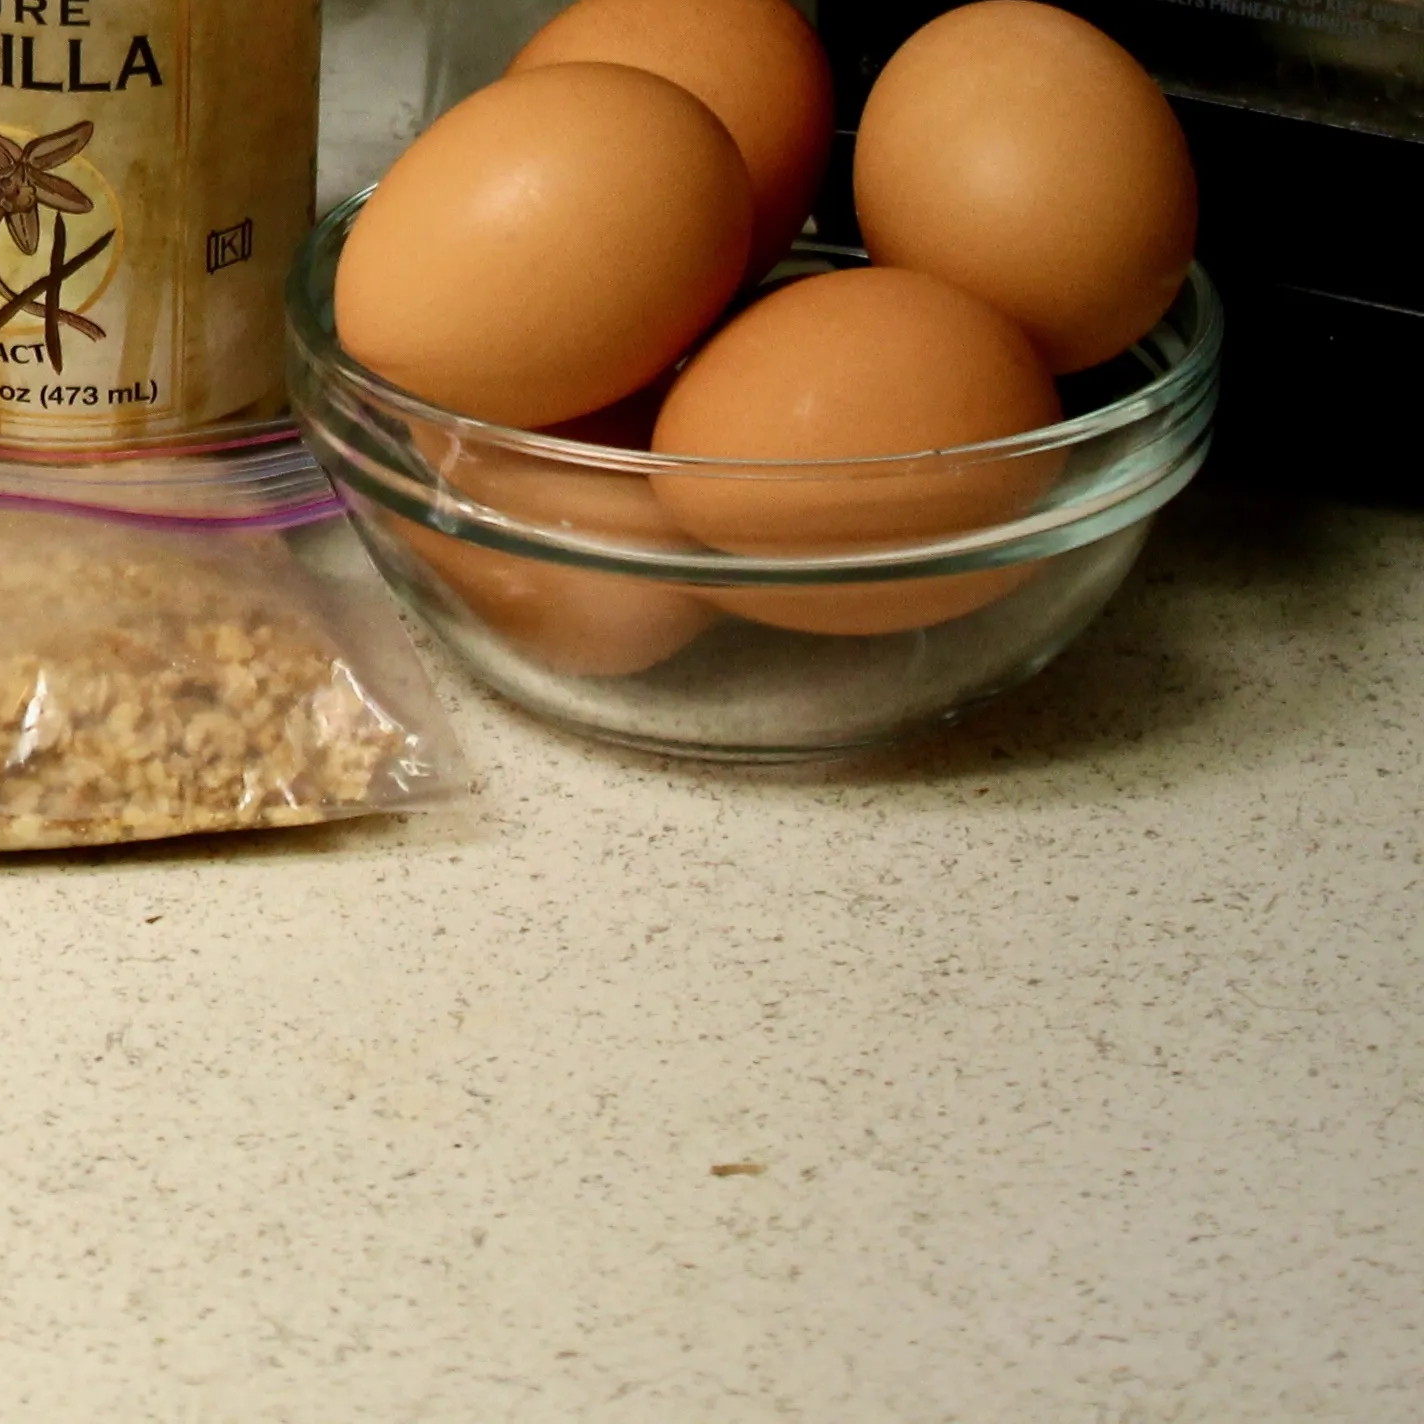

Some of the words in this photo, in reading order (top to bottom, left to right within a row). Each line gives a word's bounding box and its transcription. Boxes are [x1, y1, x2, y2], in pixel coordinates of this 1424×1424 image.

[0, 384, 31, 404] oz
[40, 384, 99, 409] (473
[108, 379, 158, 405] mL)
